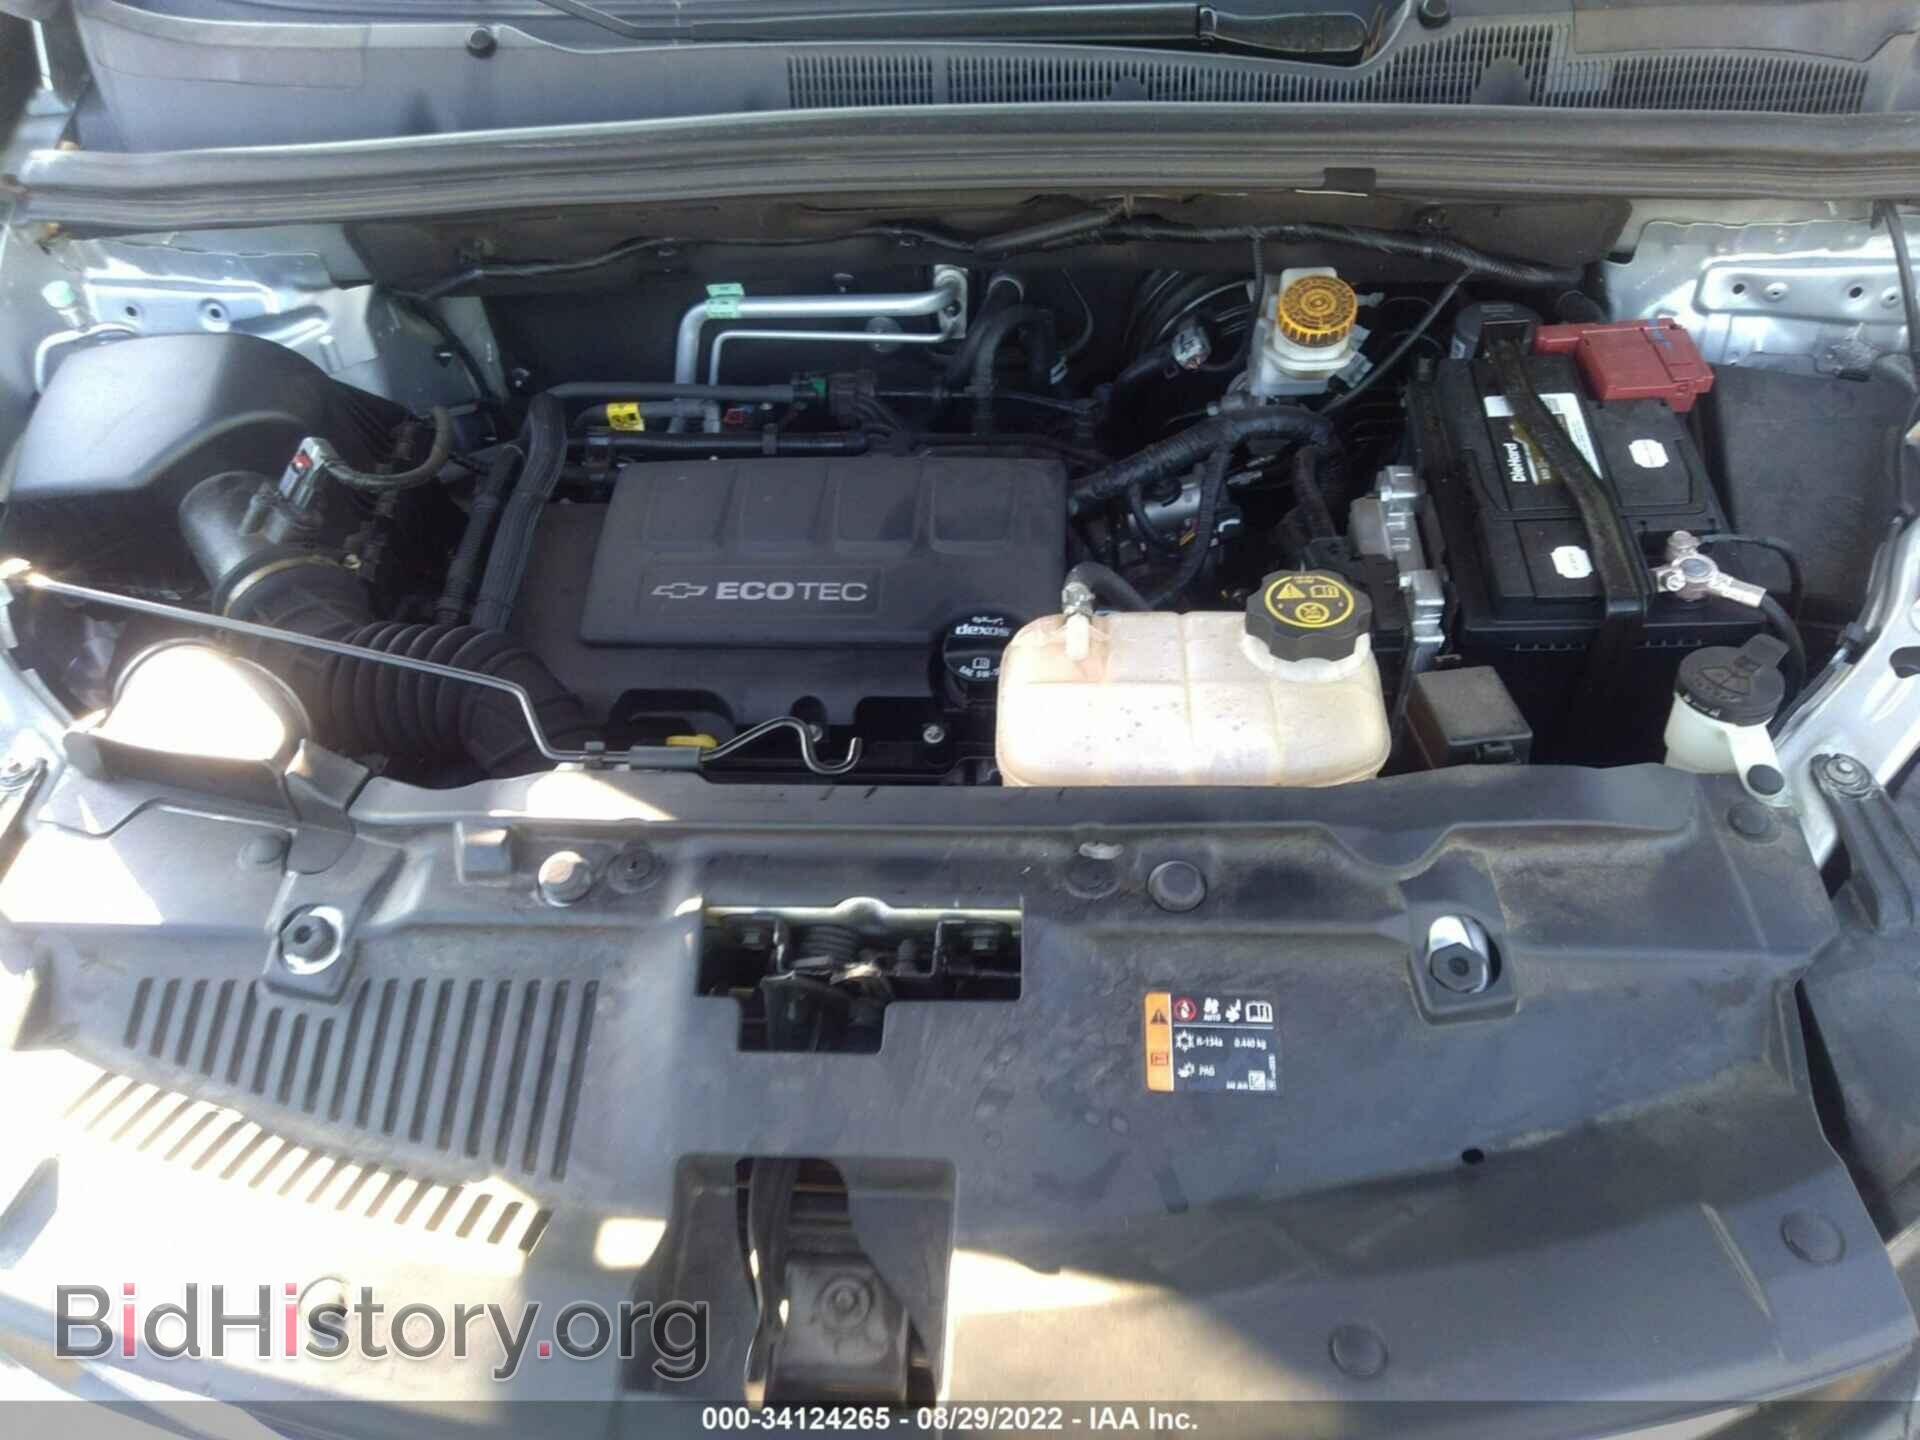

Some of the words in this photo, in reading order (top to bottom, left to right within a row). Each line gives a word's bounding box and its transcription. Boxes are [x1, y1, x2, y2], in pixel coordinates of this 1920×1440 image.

[1503, 443, 1526, 482] DieHard
[715, 582, 868, 601] ECOTEC
[955, 624, 1010, 636] dexos
